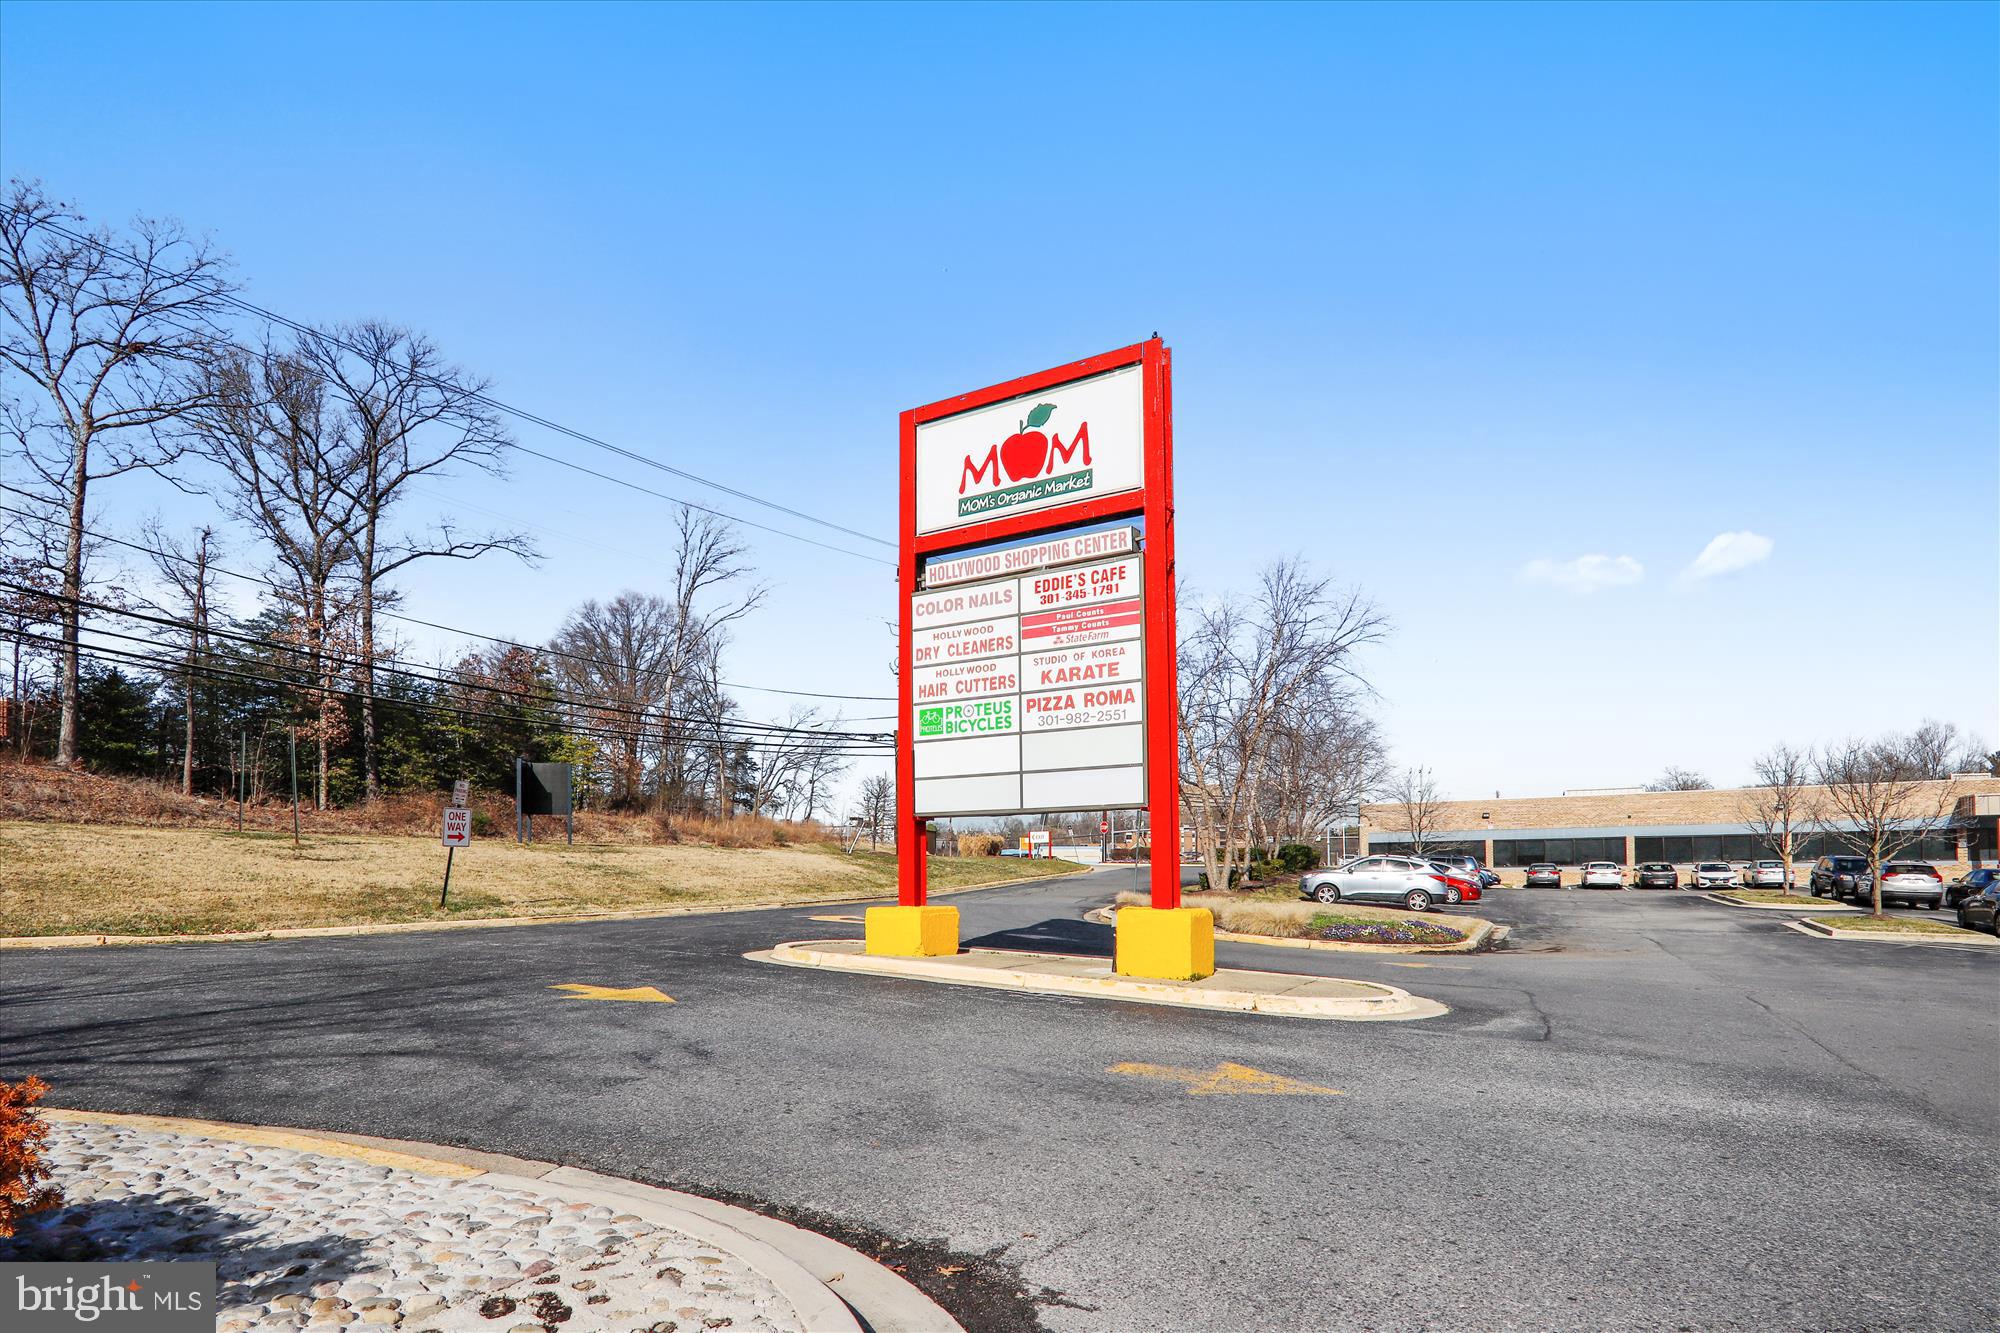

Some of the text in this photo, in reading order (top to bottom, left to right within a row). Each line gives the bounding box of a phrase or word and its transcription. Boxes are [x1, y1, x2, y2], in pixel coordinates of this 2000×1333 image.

[959, 421, 1092, 495] MOM
[959, 472, 1091, 515] MOM's Organic Market
[929, 531, 1128, 583] HOLLYWOOD SHOPPING CENTER
[1034, 565, 1126, 594] EDDIE'S CAFE
[915, 588, 1013, 617] COLOR NAILS
[1040, 583, 1119, 605] 301-345-1791
[1056, 608, 1105, 621] Paul Counts
[933, 625, 994, 641] HOLLYWOOD
[1052, 619, 1110, 634] Tammy Counts
[916, 635, 1014, 662] DRY CLEANERS
[1033, 647, 1126, 667] STUDIO OF KOREA
[935, 663, 997, 678] HOLLYWOOD
[1040, 661, 1120, 685] KARATE
[918, 674, 1016, 699] HAIR CUTTERS
[945, 700, 1012, 720] PROTEUS
[1026, 688, 1136, 714] PIZZA ROMA
[945, 715, 1013, 734] BICYCLES
[1038, 708, 1127, 727] 301-982-2551
[448, 811, 466, 821] ONE
[447, 822, 467, 832] WAY
